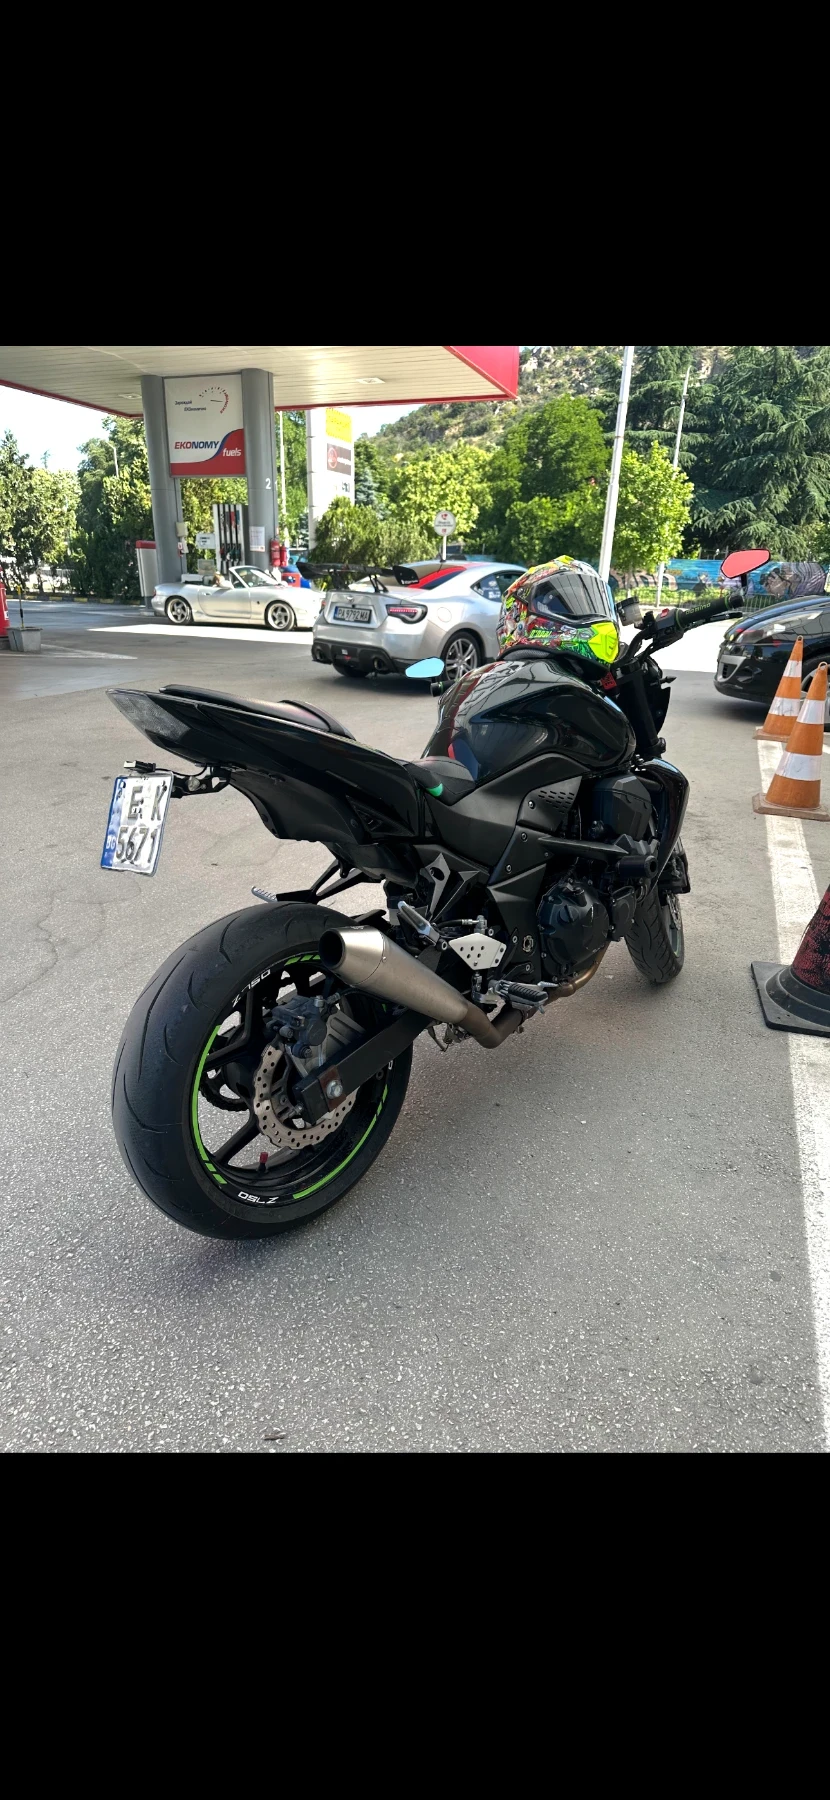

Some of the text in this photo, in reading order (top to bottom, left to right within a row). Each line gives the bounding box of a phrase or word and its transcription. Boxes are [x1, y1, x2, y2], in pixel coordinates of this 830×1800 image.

[174, 440, 220, 450] EKONOMY
[222, 447, 242, 457] fuels
[265, 477, 272, 490] 2
[105, 835, 117, 850] BG
[116, 826, 158, 864] 5671
